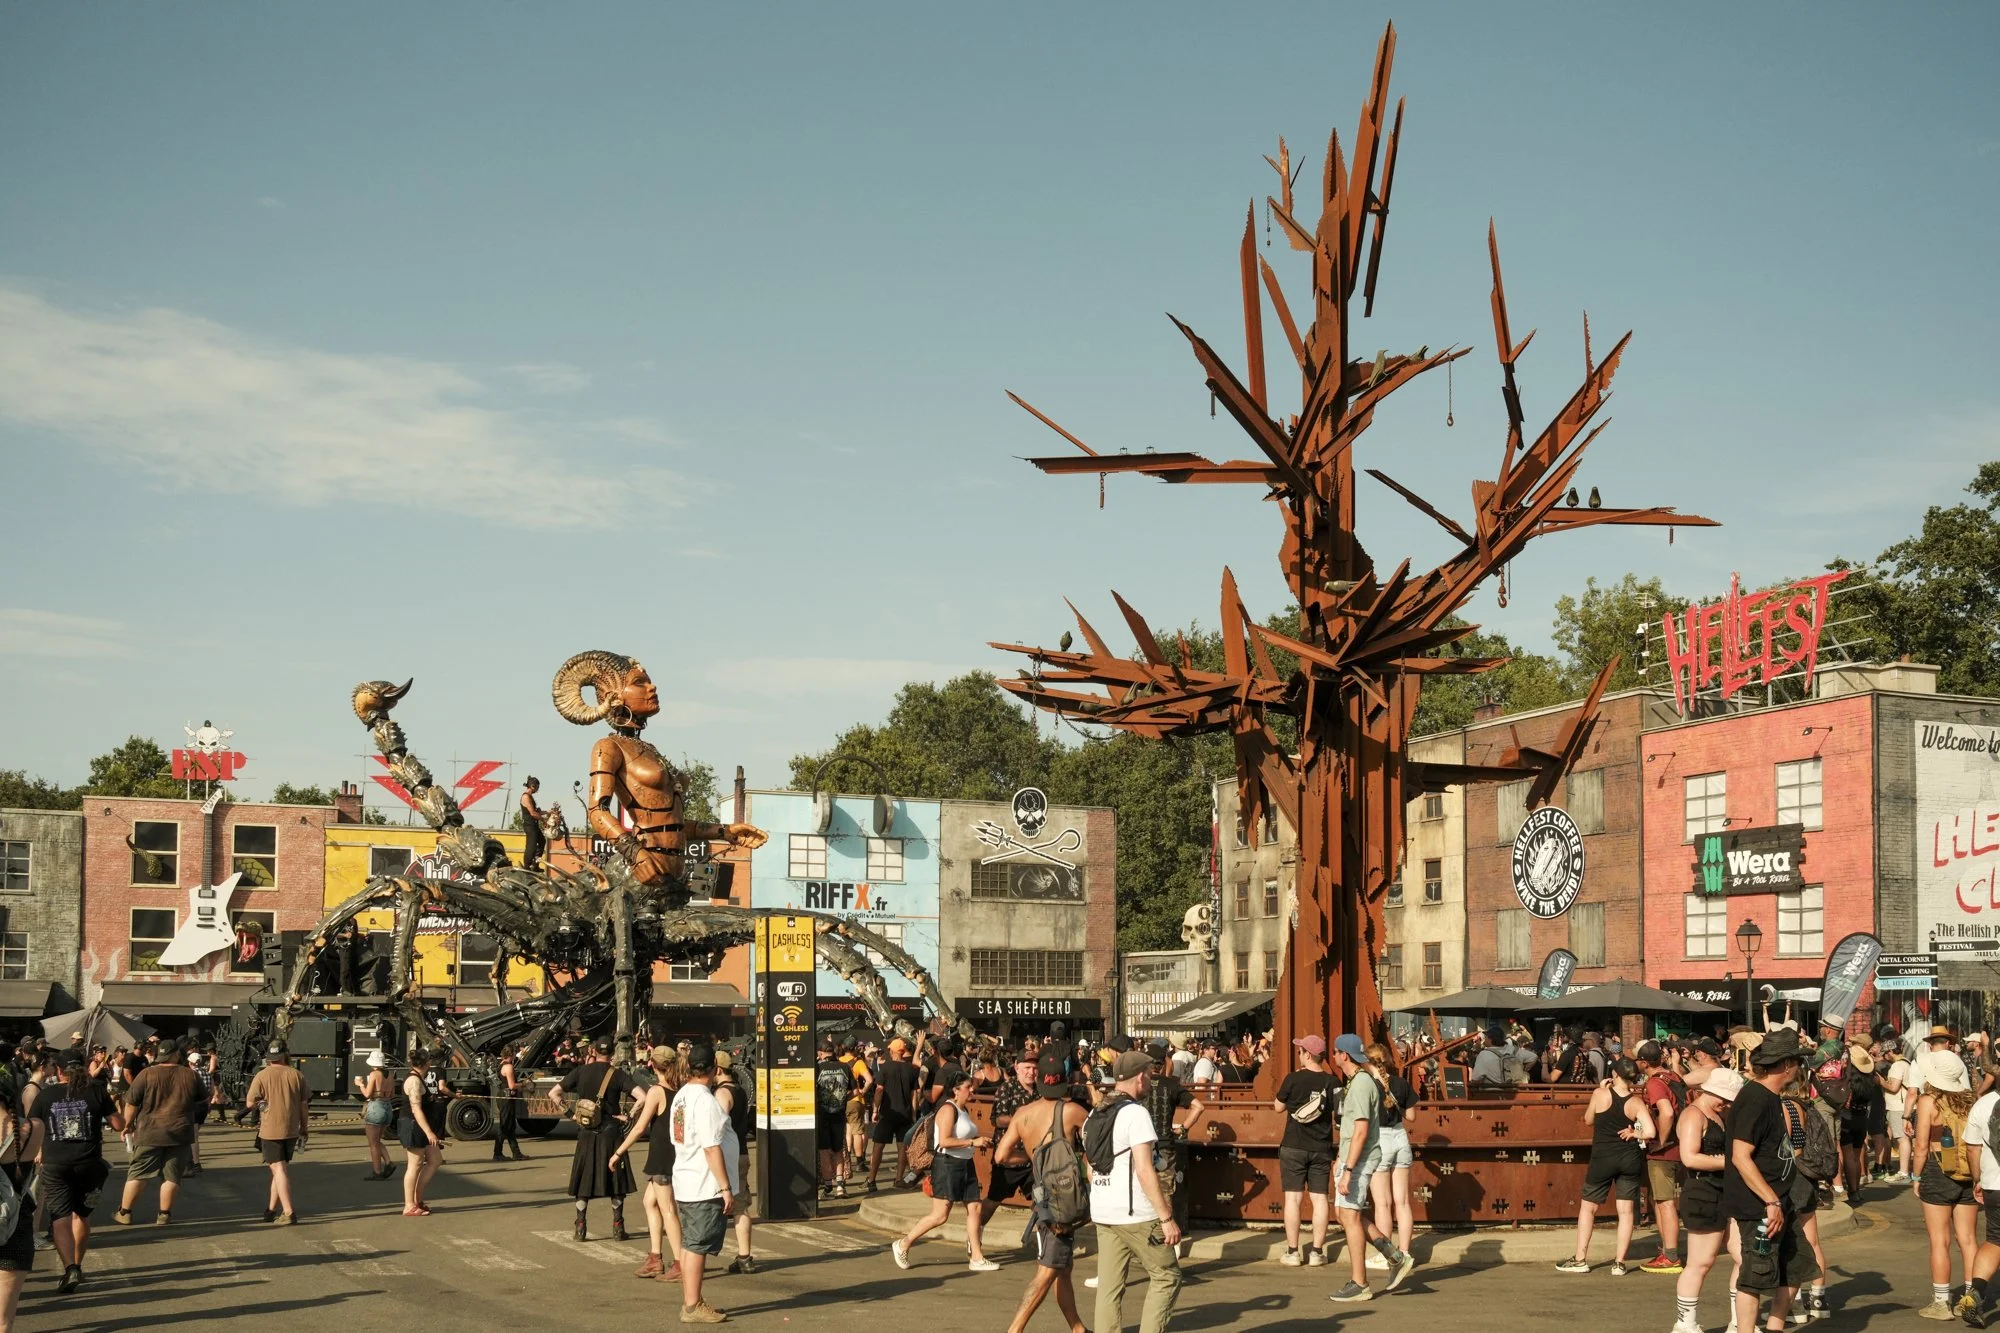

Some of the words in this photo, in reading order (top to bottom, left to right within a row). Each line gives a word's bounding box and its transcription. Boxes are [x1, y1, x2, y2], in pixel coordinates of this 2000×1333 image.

[1663, 570, 1850, 718] HELLFEST
[1922, 725, 1986, 752] Welcome
[1988, 731, 2000, 753] to
[172, 749, 247, 781] ESP
[1514, 810, 1552, 861] HELLFEST
[1553, 812, 1581, 855] COFFEE
[1726, 850, 1791, 875] Wera
[1752, 875, 1767, 885] TOOL
[1769, 874, 1791, 884] REBEL
[805, 882, 888, 911] RIFFX.fr
[1516, 878, 1537, 911] WAKE
[1539, 900, 1556, 915] THE
[1557, 871, 1580, 909] DEAD!
[772, 933, 811, 949] CASHLESS
[1936, 923, 1955, 937] The
[1958, 924, 1991, 938] Hellish
[1549, 957, 1567, 987] Wera
[1842, 943, 1869, 976] Wera
[821, 1003, 854, 1011] MUSIQUES,
[978, 1000, 1002, 1014] SEA
[1007, 1000, 1071, 1015] SHEPHERD
[1705, 990, 1732, 1002] REBEL
[193, 1007, 212, 1016] ESP
[1095, 1178, 1111, 1187] ORT
